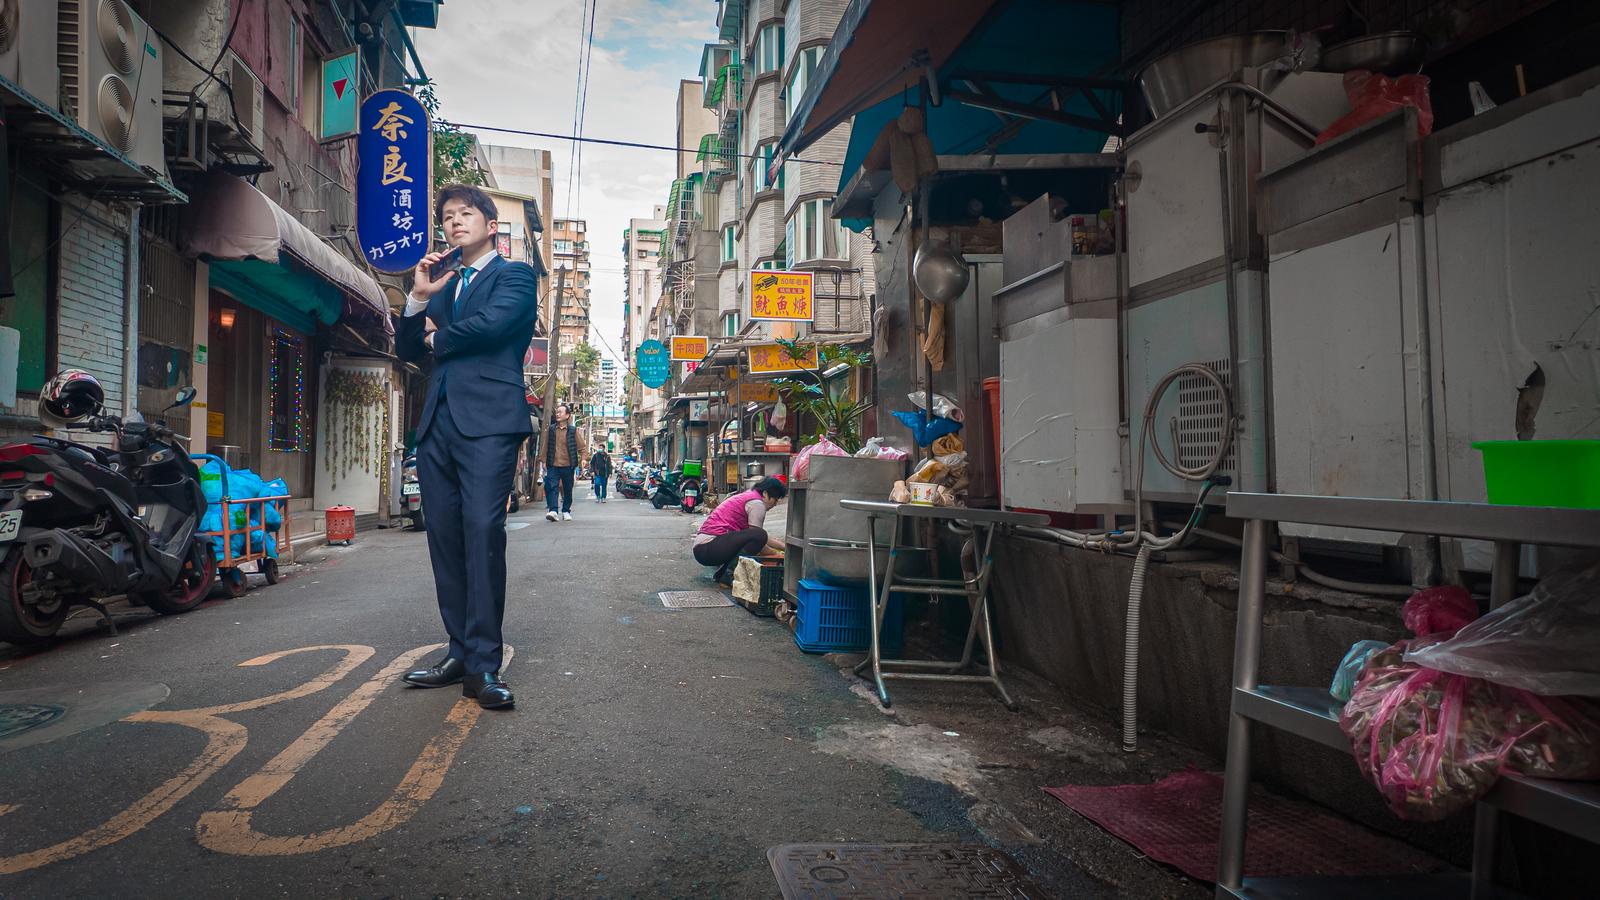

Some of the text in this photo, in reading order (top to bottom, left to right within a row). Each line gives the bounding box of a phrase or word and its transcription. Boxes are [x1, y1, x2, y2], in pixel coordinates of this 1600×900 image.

[372, 101, 414, 186] 奈良
[392, 189, 414, 231] 酒坊
[369, 231, 424, 260] カラオケ
[676, 343, 705, 355] 牛肉麵
